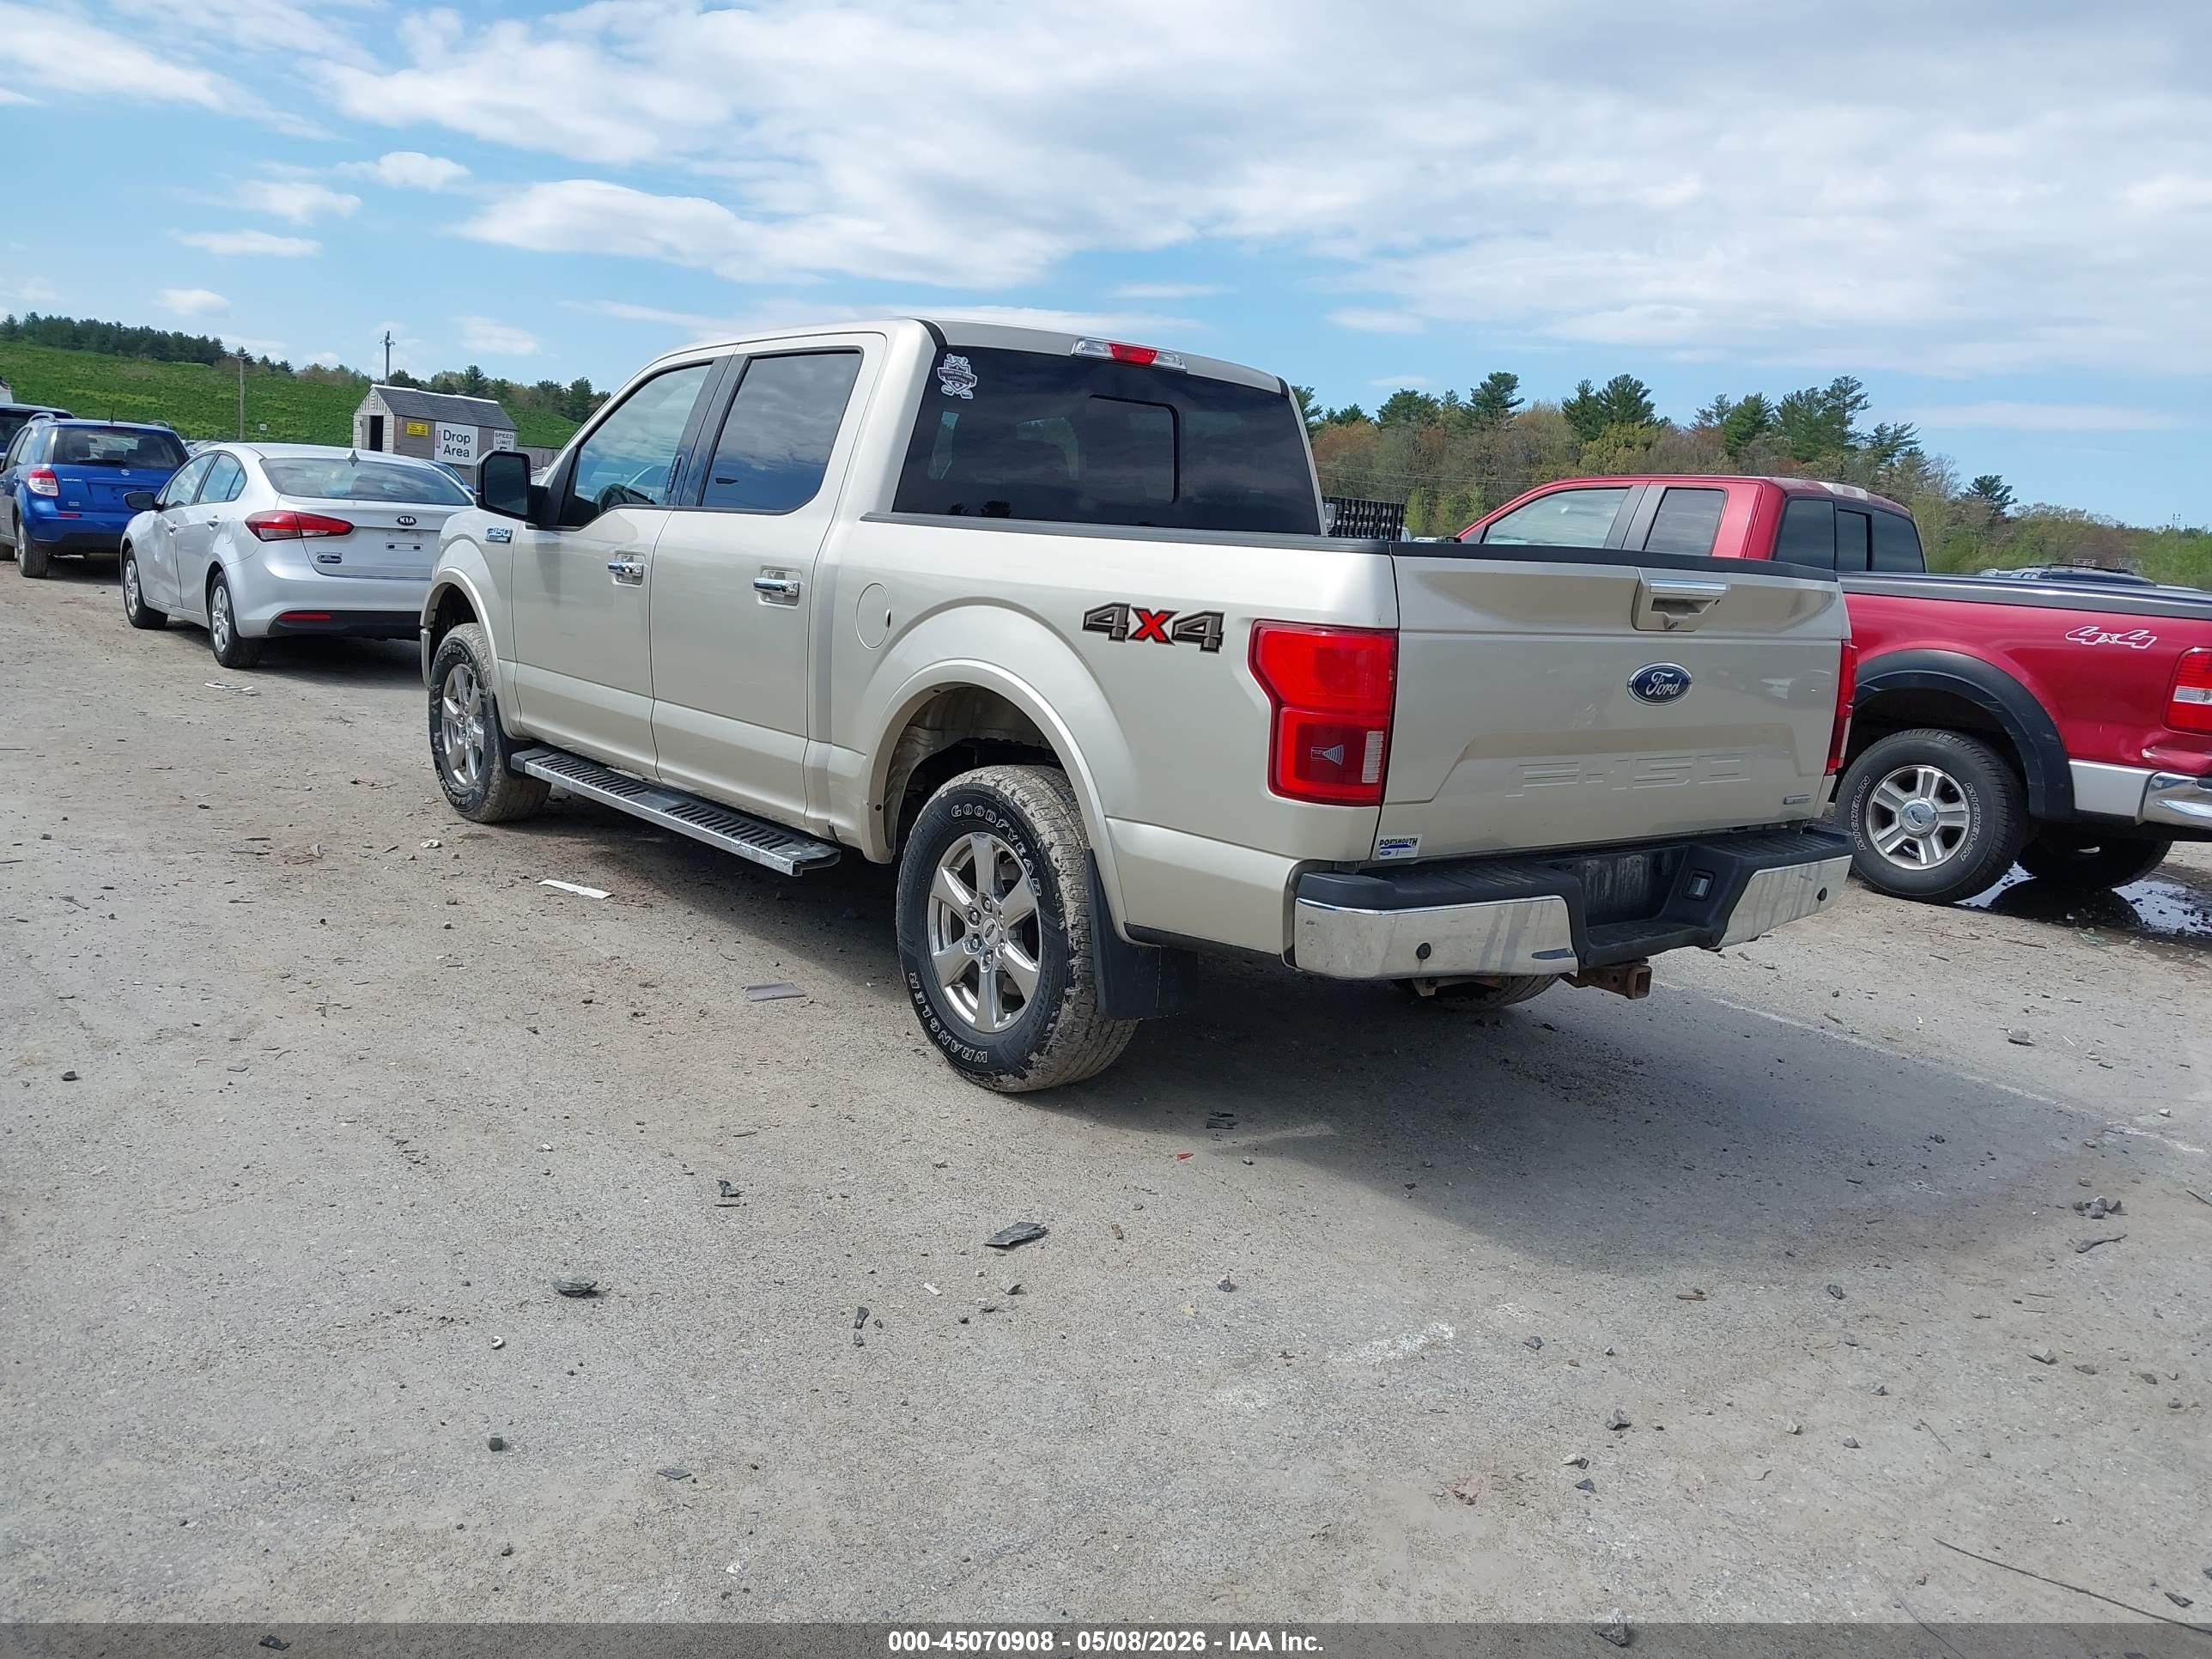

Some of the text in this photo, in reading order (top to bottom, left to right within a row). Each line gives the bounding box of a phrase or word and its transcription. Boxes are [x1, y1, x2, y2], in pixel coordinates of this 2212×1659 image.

[443, 429, 471, 445] Drop
[443, 444, 470, 458] Area
[2065, 625, 2157, 649] 4x4
[1645, 672, 1682, 696] Ford
[1850, 775, 1871, 851] MICHELIN
[1960, 782, 1981, 862] MICHELIN
[951, 803, 1042, 896] GOODYEAR
[1379, 837, 1419, 847] PORTSMOUTH
[908, 971, 988, 1063] WRANGLER
